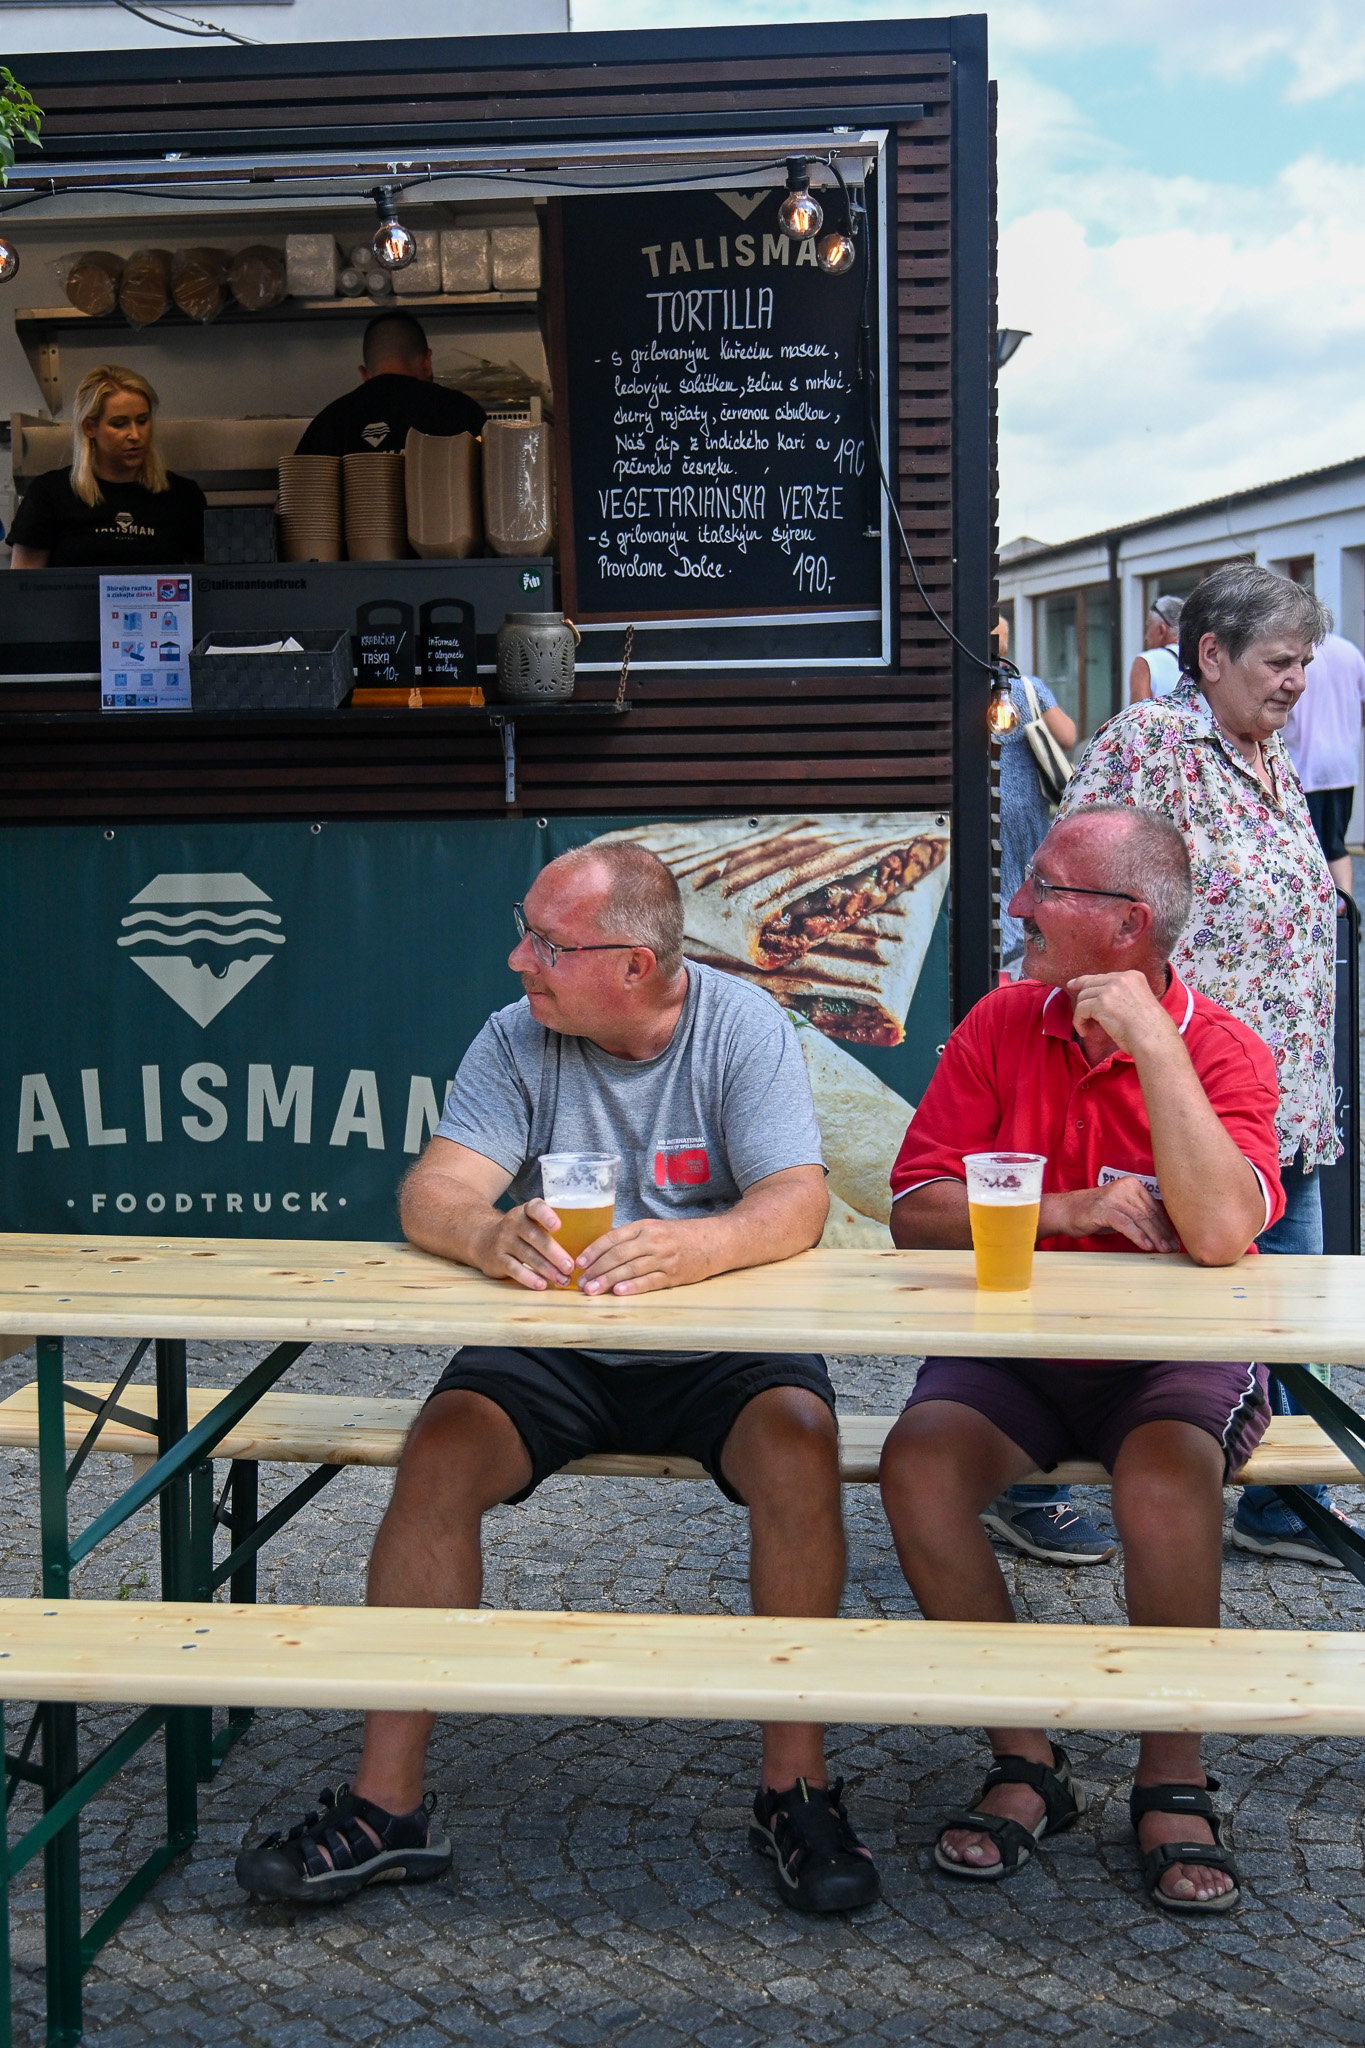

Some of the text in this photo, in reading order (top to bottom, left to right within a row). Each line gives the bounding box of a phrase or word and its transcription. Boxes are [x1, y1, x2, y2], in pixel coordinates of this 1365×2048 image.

[641, 233, 819, 278] TALISMA
[646, 286, 774, 334] TORTILLA
[631, 340, 710, 374] grilovaným
[614, 374, 672, 409] ledovým
[613, 405, 654, 434] cherry
[720, 403, 770, 421] červenou
[614, 431, 646, 455] Náš
[655, 434, 680, 460] dip
[705, 429, 769, 451] indického
[613, 452, 671, 482] pečeného
[779, 483, 844, 521] VERZE
[616, 522, 689, 557] grilovaným
[698, 523, 763, 555] italským
[771, 523, 817, 556] sýrem
[597, 553, 667, 580] Provolone
[91, 1191, 329, 1214] FOODTRUCK
